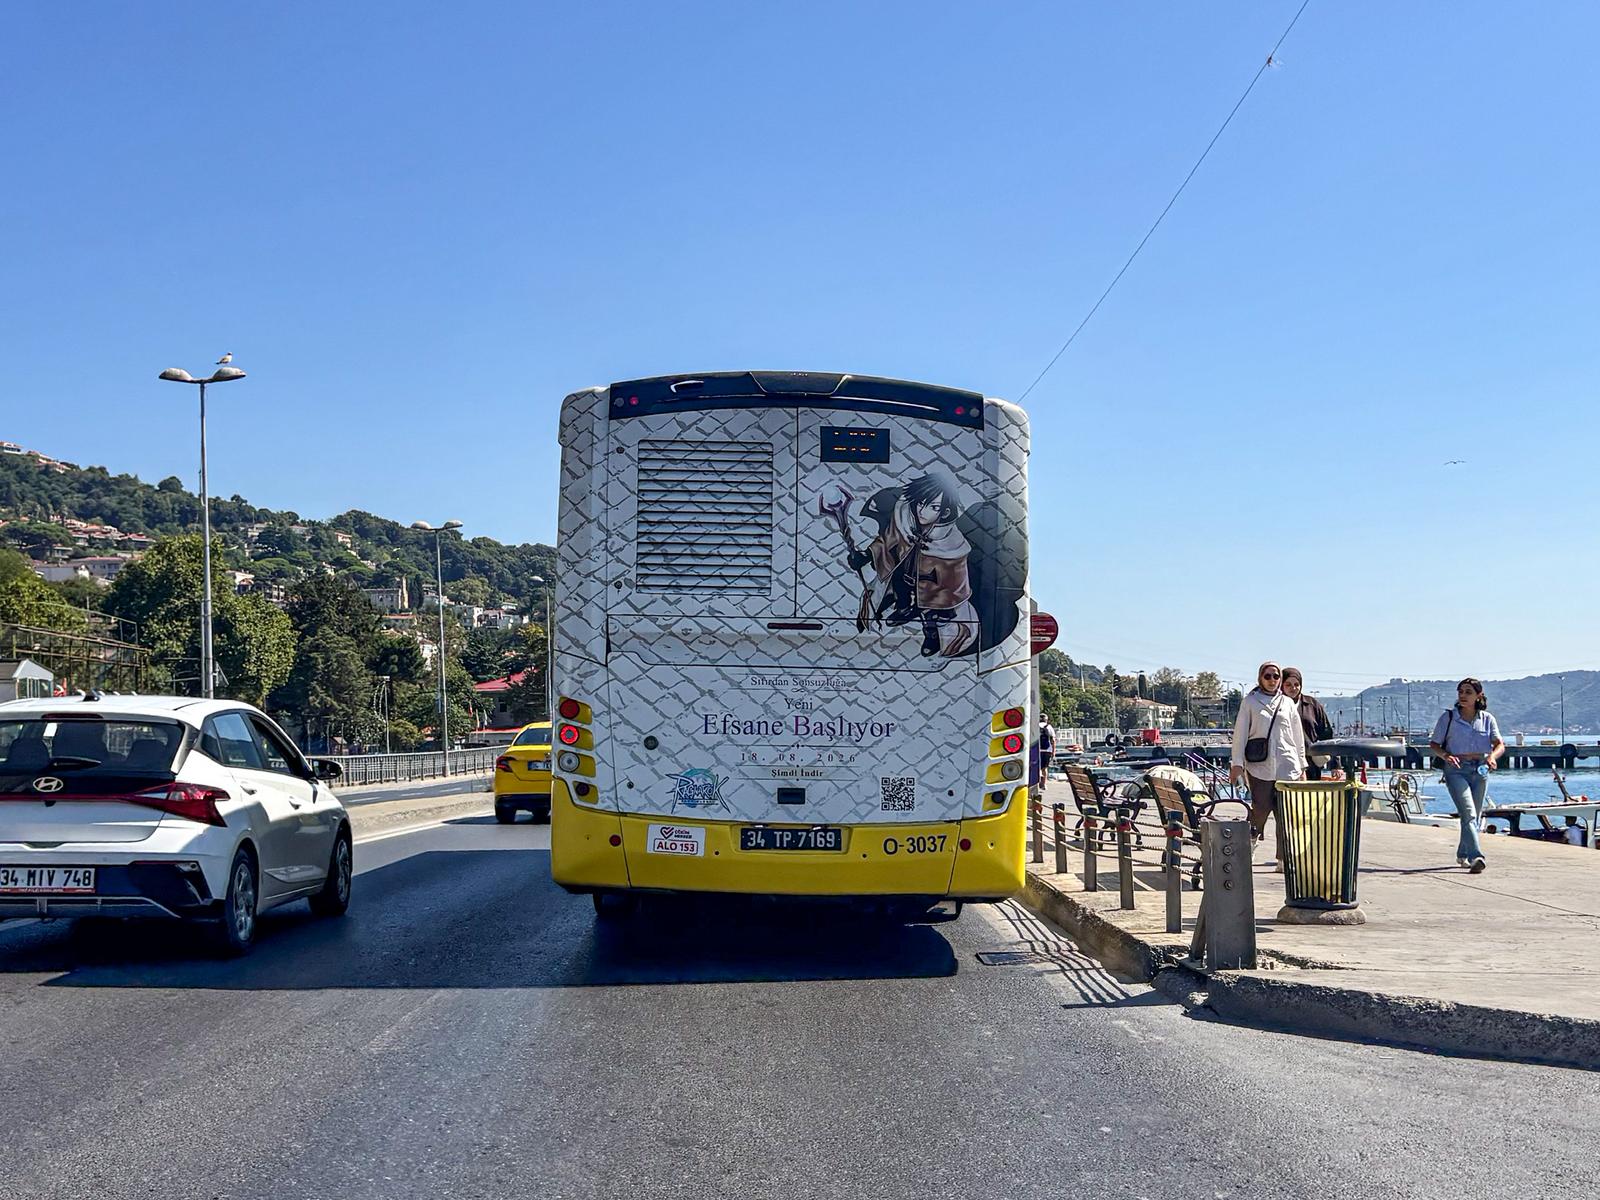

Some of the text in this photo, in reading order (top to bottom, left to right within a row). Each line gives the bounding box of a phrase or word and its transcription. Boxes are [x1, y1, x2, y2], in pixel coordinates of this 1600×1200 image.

[784, 697, 813, 710] Yeni
[703, 713, 895, 743] Efsane Başlıyor
[771, 767, 824, 778] Şimdi İndir
[656, 841, 695, 852] ALO 153
[747, 831, 836, 848] 34 TP 7169
[0, 869, 92, 887] 34 MIV 748
